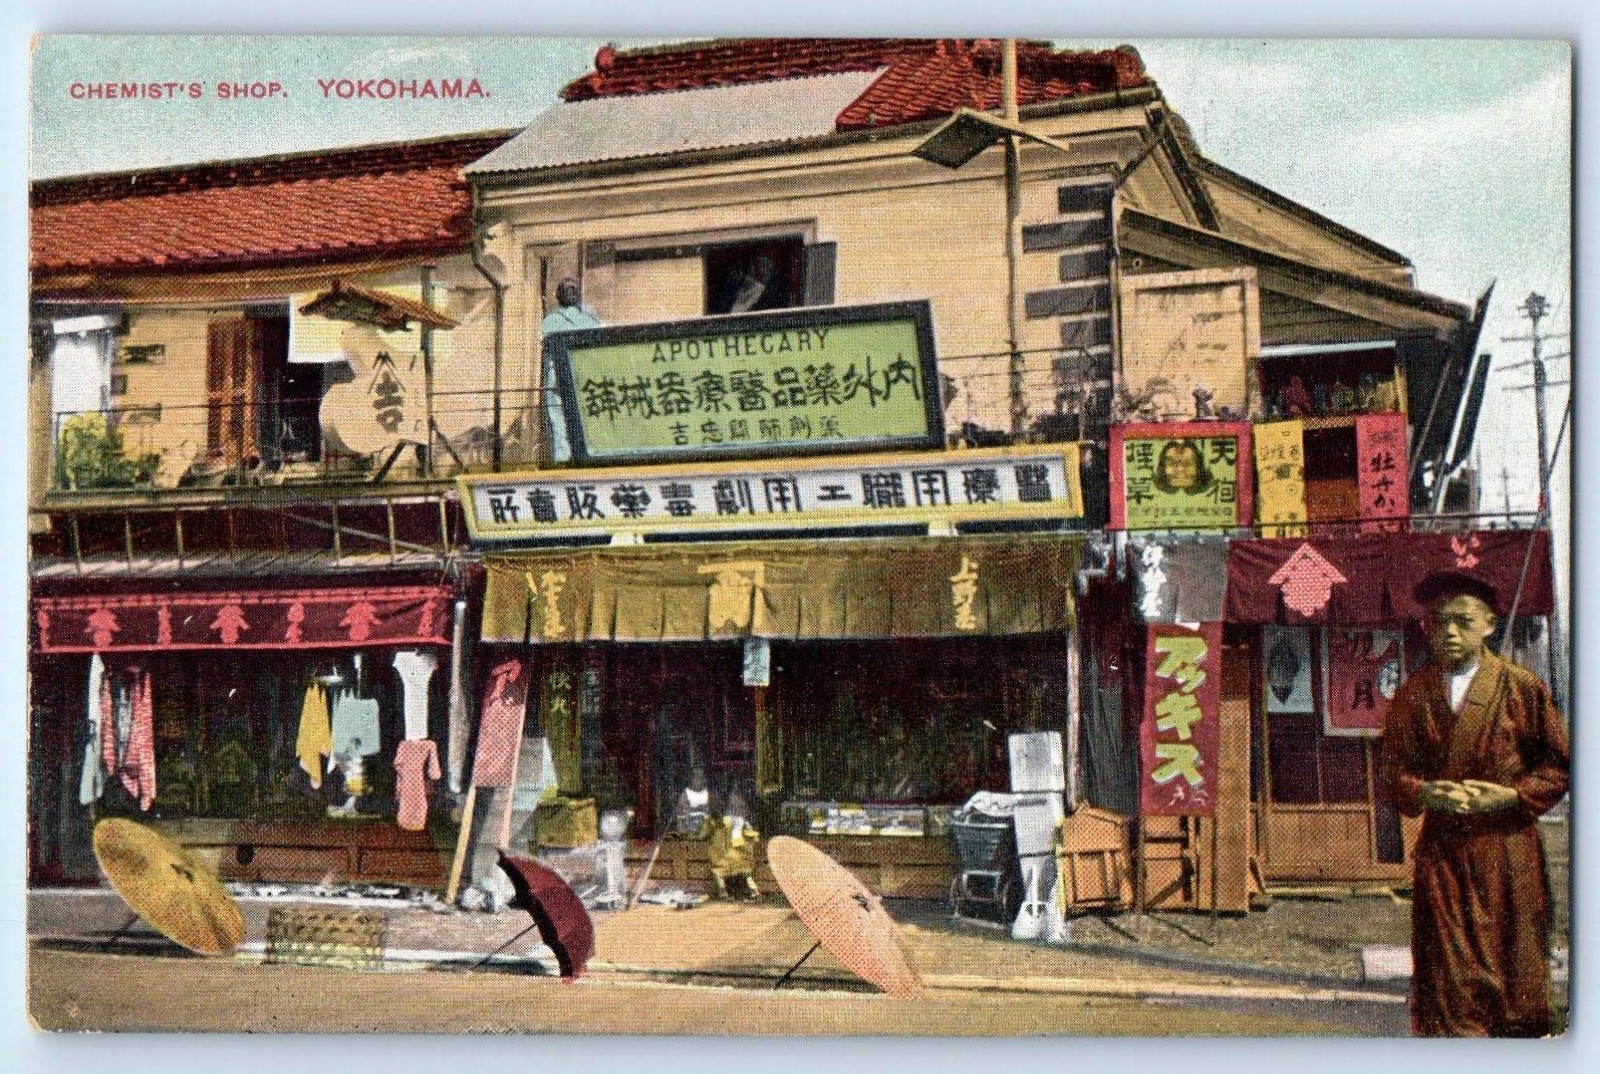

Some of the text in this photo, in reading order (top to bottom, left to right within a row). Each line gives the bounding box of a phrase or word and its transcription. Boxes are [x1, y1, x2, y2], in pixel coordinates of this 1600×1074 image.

[651, 328, 831, 364] APOTHECARY
[1151, 635, 1209, 787] アッキス
